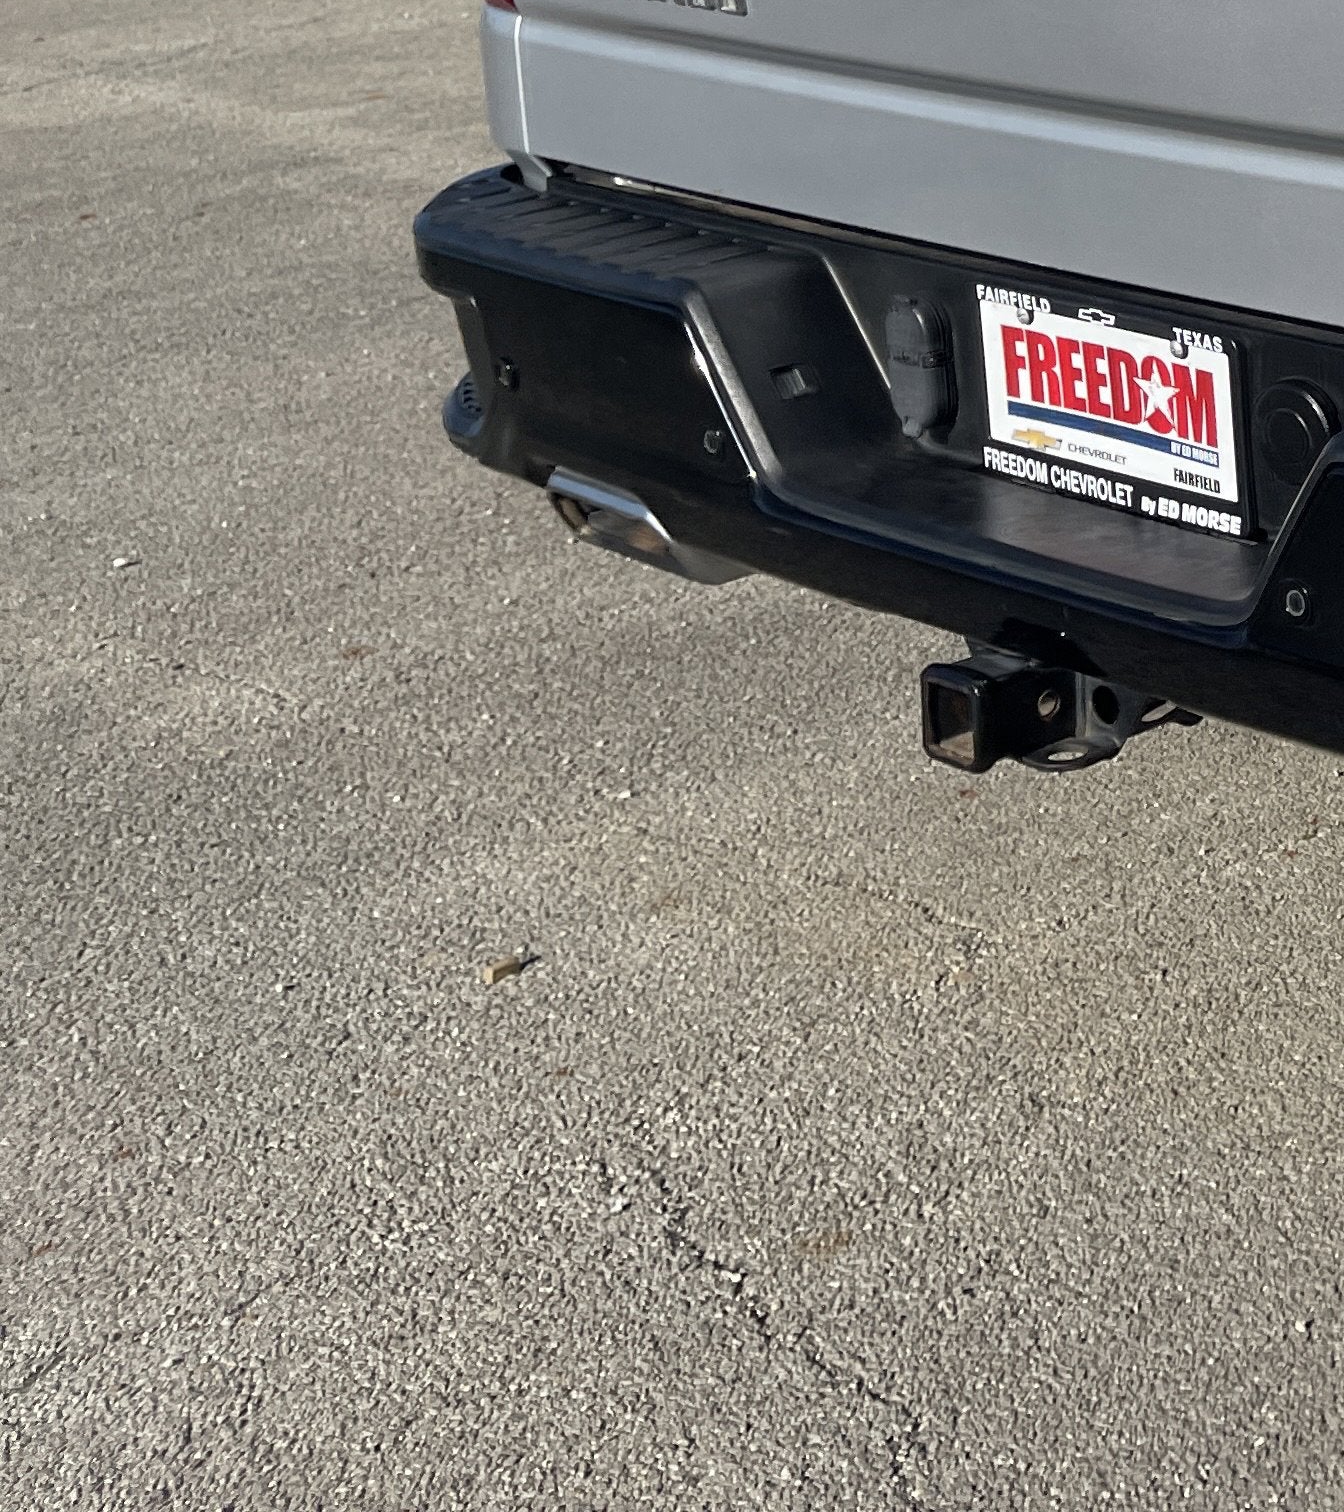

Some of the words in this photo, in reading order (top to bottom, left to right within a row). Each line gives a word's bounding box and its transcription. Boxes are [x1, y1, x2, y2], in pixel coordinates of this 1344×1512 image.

[976, 284, 1051, 312] FAIRFIELD
[1172, 327, 1223, 353] TEXAS
[1000, 324, 1218, 448] FREEDOM
[1067, 443, 1128, 466] CHEVROLET
[1181, 444, 1192, 459] ED
[1192, 446, 1219, 466] MORSE
[983, 446, 1049, 485] FREEDOM
[1050, 465, 1134, 507] CHEVROLET
[1157, 497, 1180, 519] ED
[1181, 502, 1242, 536] MORSE
[1174, 468, 1221, 494] FAIRFIELD
